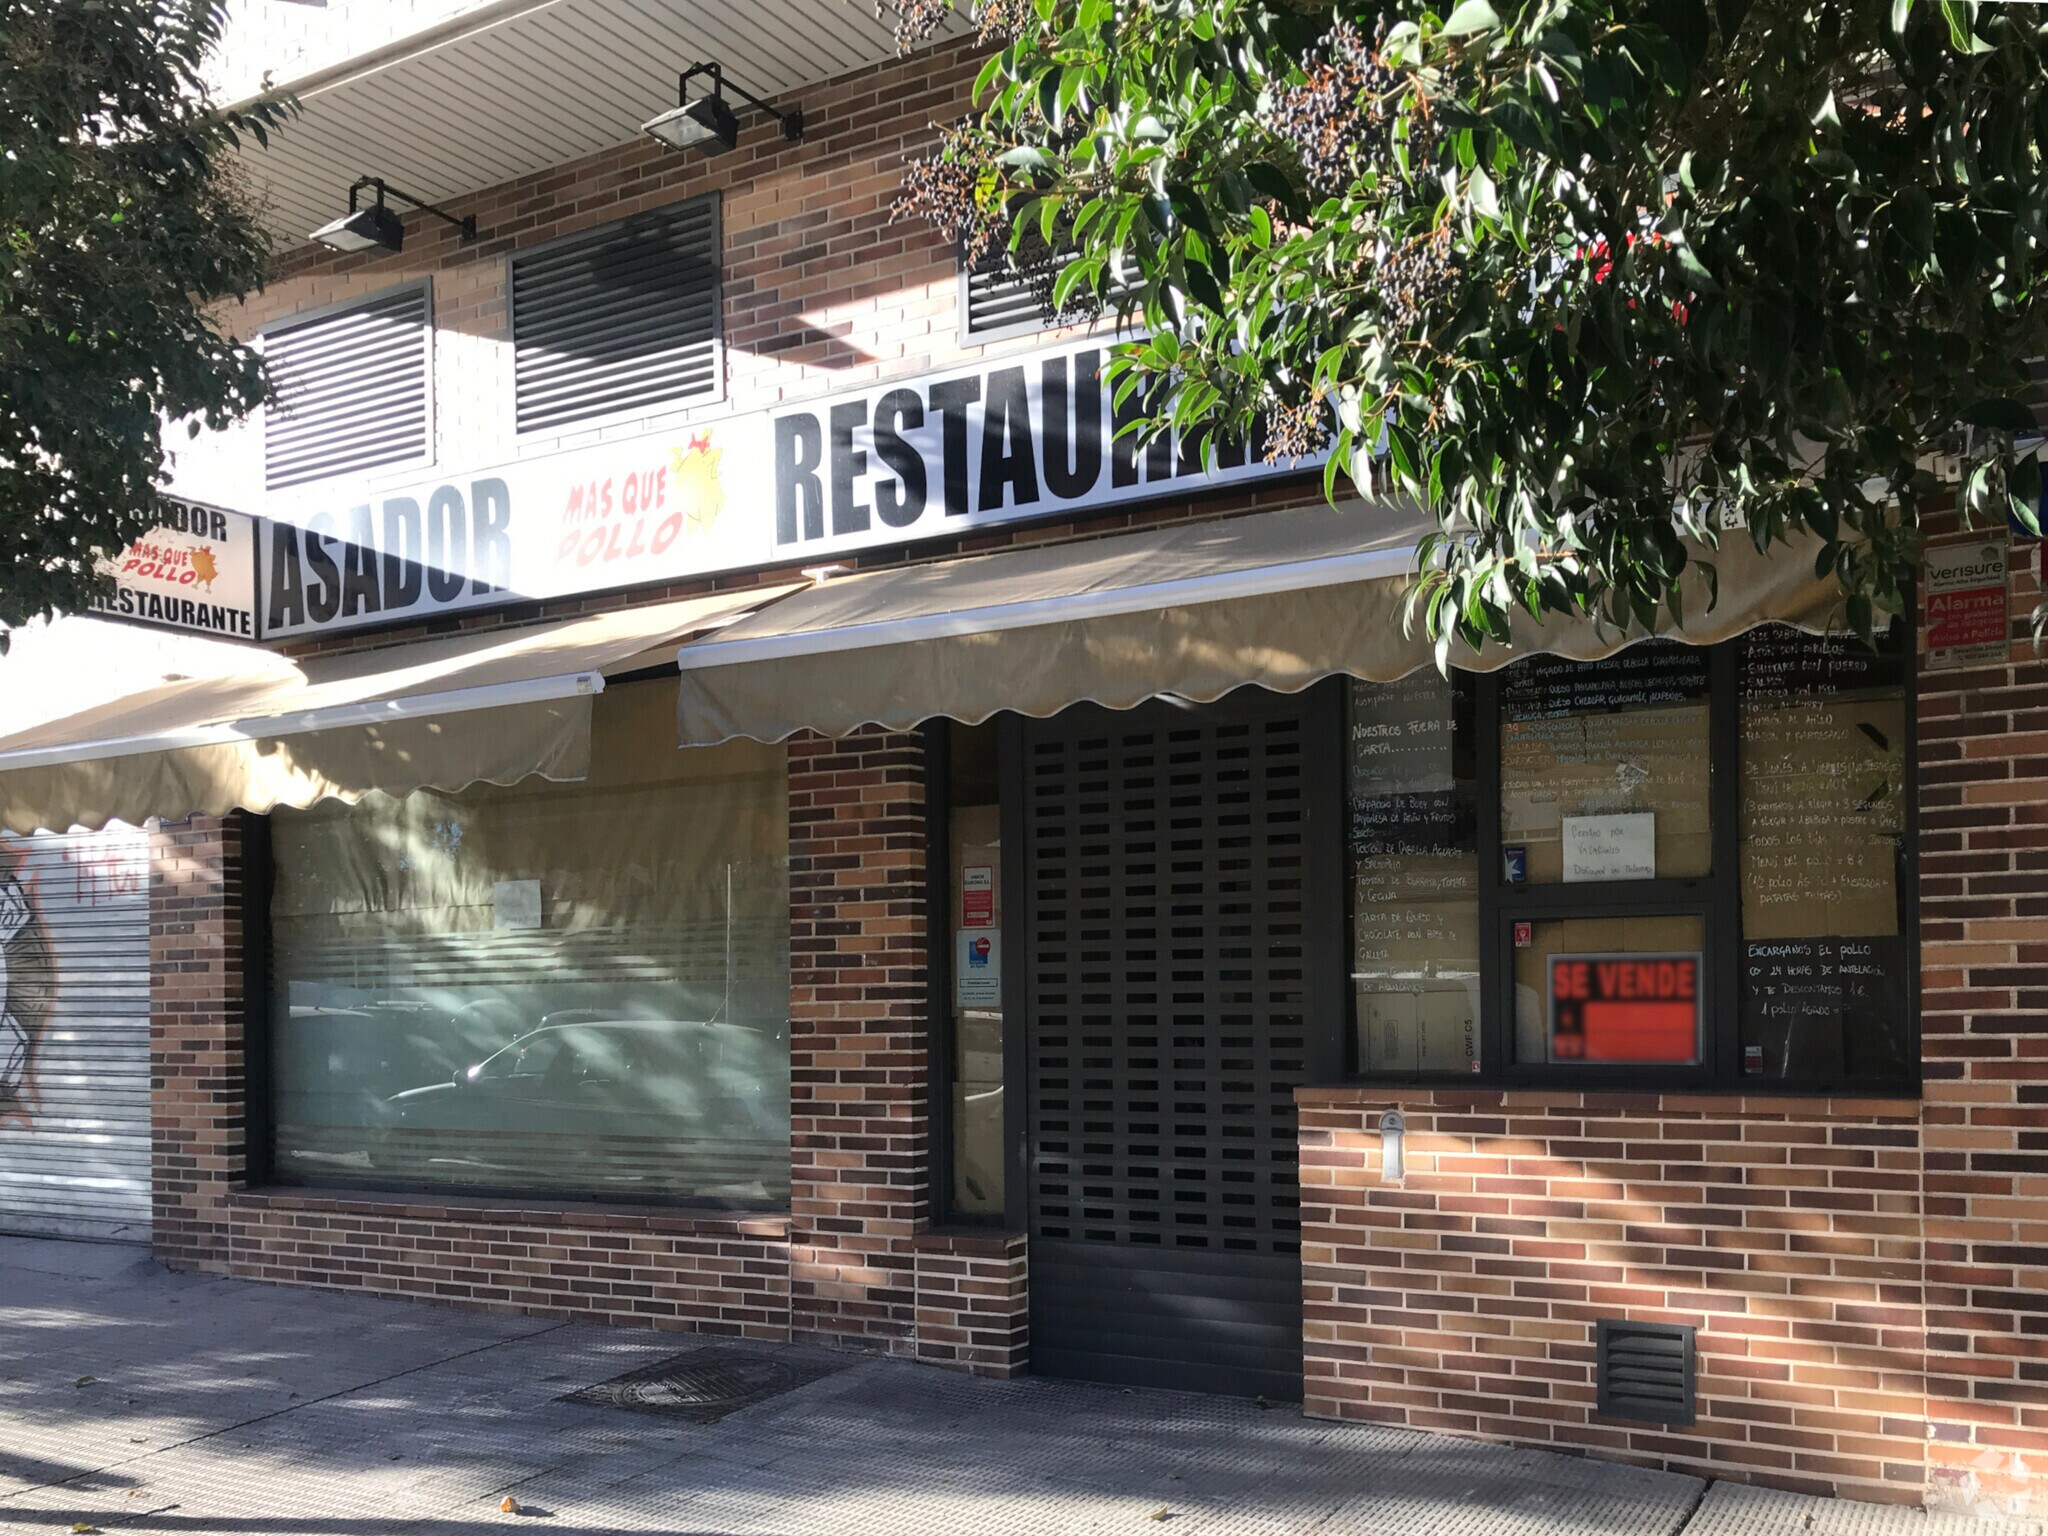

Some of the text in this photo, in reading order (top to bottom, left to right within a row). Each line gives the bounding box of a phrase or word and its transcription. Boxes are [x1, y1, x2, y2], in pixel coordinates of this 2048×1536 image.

[562, 465, 666, 523] MAS QUE
[553, 511, 684, 569] POLLO
[129, 540, 188, 567] MAS QUE
[267, 478, 510, 632] ASADOR
[120, 558, 196, 585] POLLO
[1929, 561, 2004, 580] verisure
[1930, 593, 2005, 613] Alarma
[1933, 632, 1960, 642] Aviso
[1406, 719, 1441, 735] FUERA
[1446, 719, 1458, 731] DE
[1357, 928, 1402, 942] CHOCOLATE
[1818, 945, 1832, 957] EL
[1553, 960, 1696, 999] SE VENDE
[1769, 965, 1782, 977] 24
[1820, 964, 1832, 976] DE
